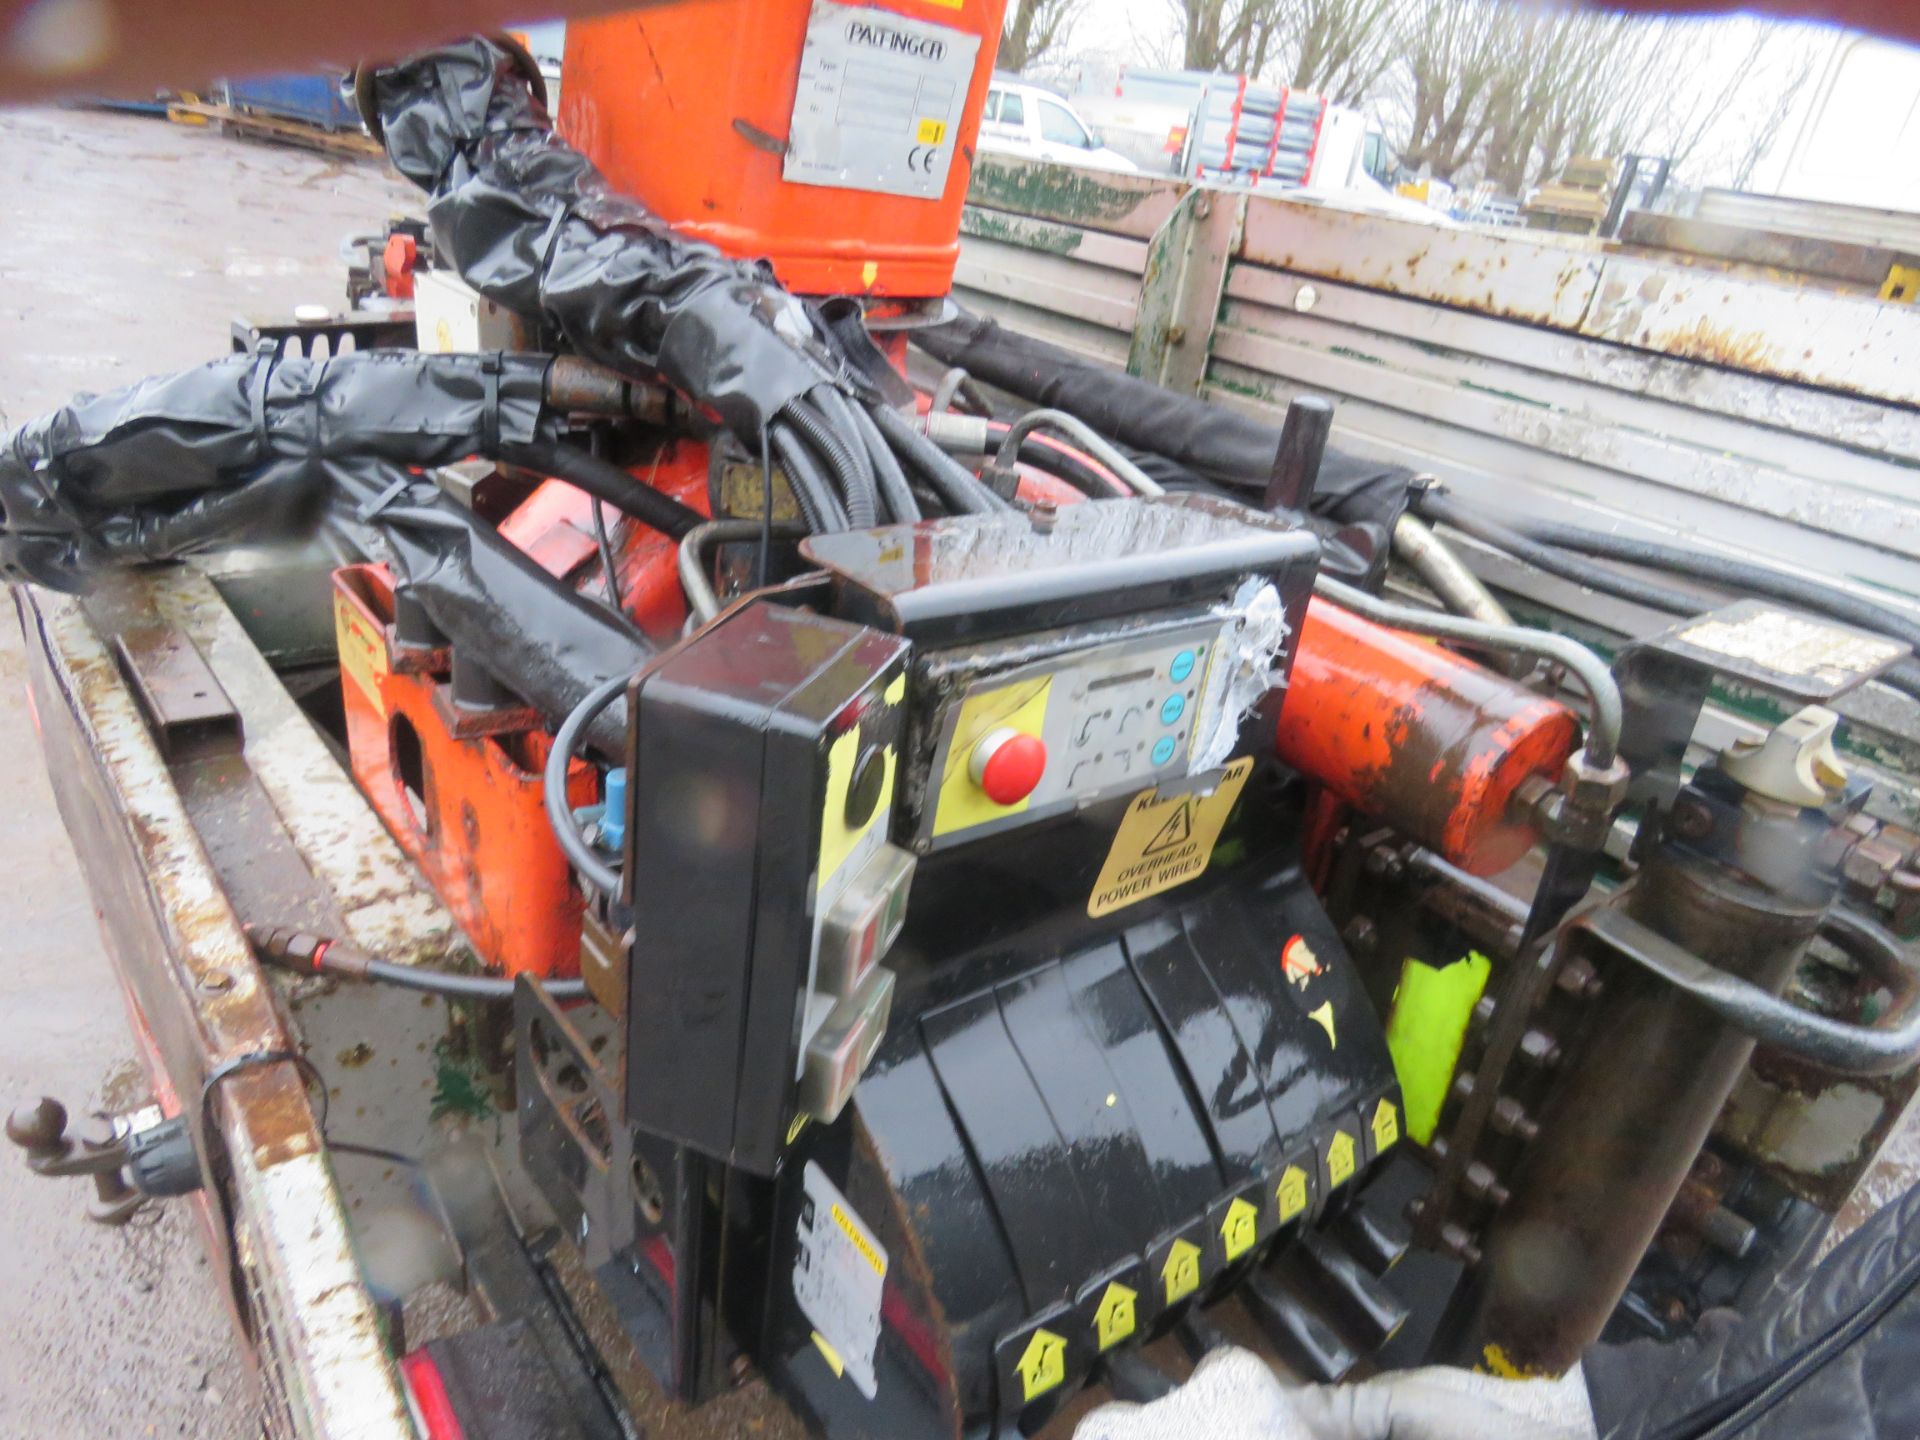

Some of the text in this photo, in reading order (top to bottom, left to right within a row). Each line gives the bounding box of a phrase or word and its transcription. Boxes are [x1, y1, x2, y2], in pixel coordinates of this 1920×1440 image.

[1097, 855, 1202, 908] POWER WIRES
[1117, 843, 1198, 883] OVERHEAD
